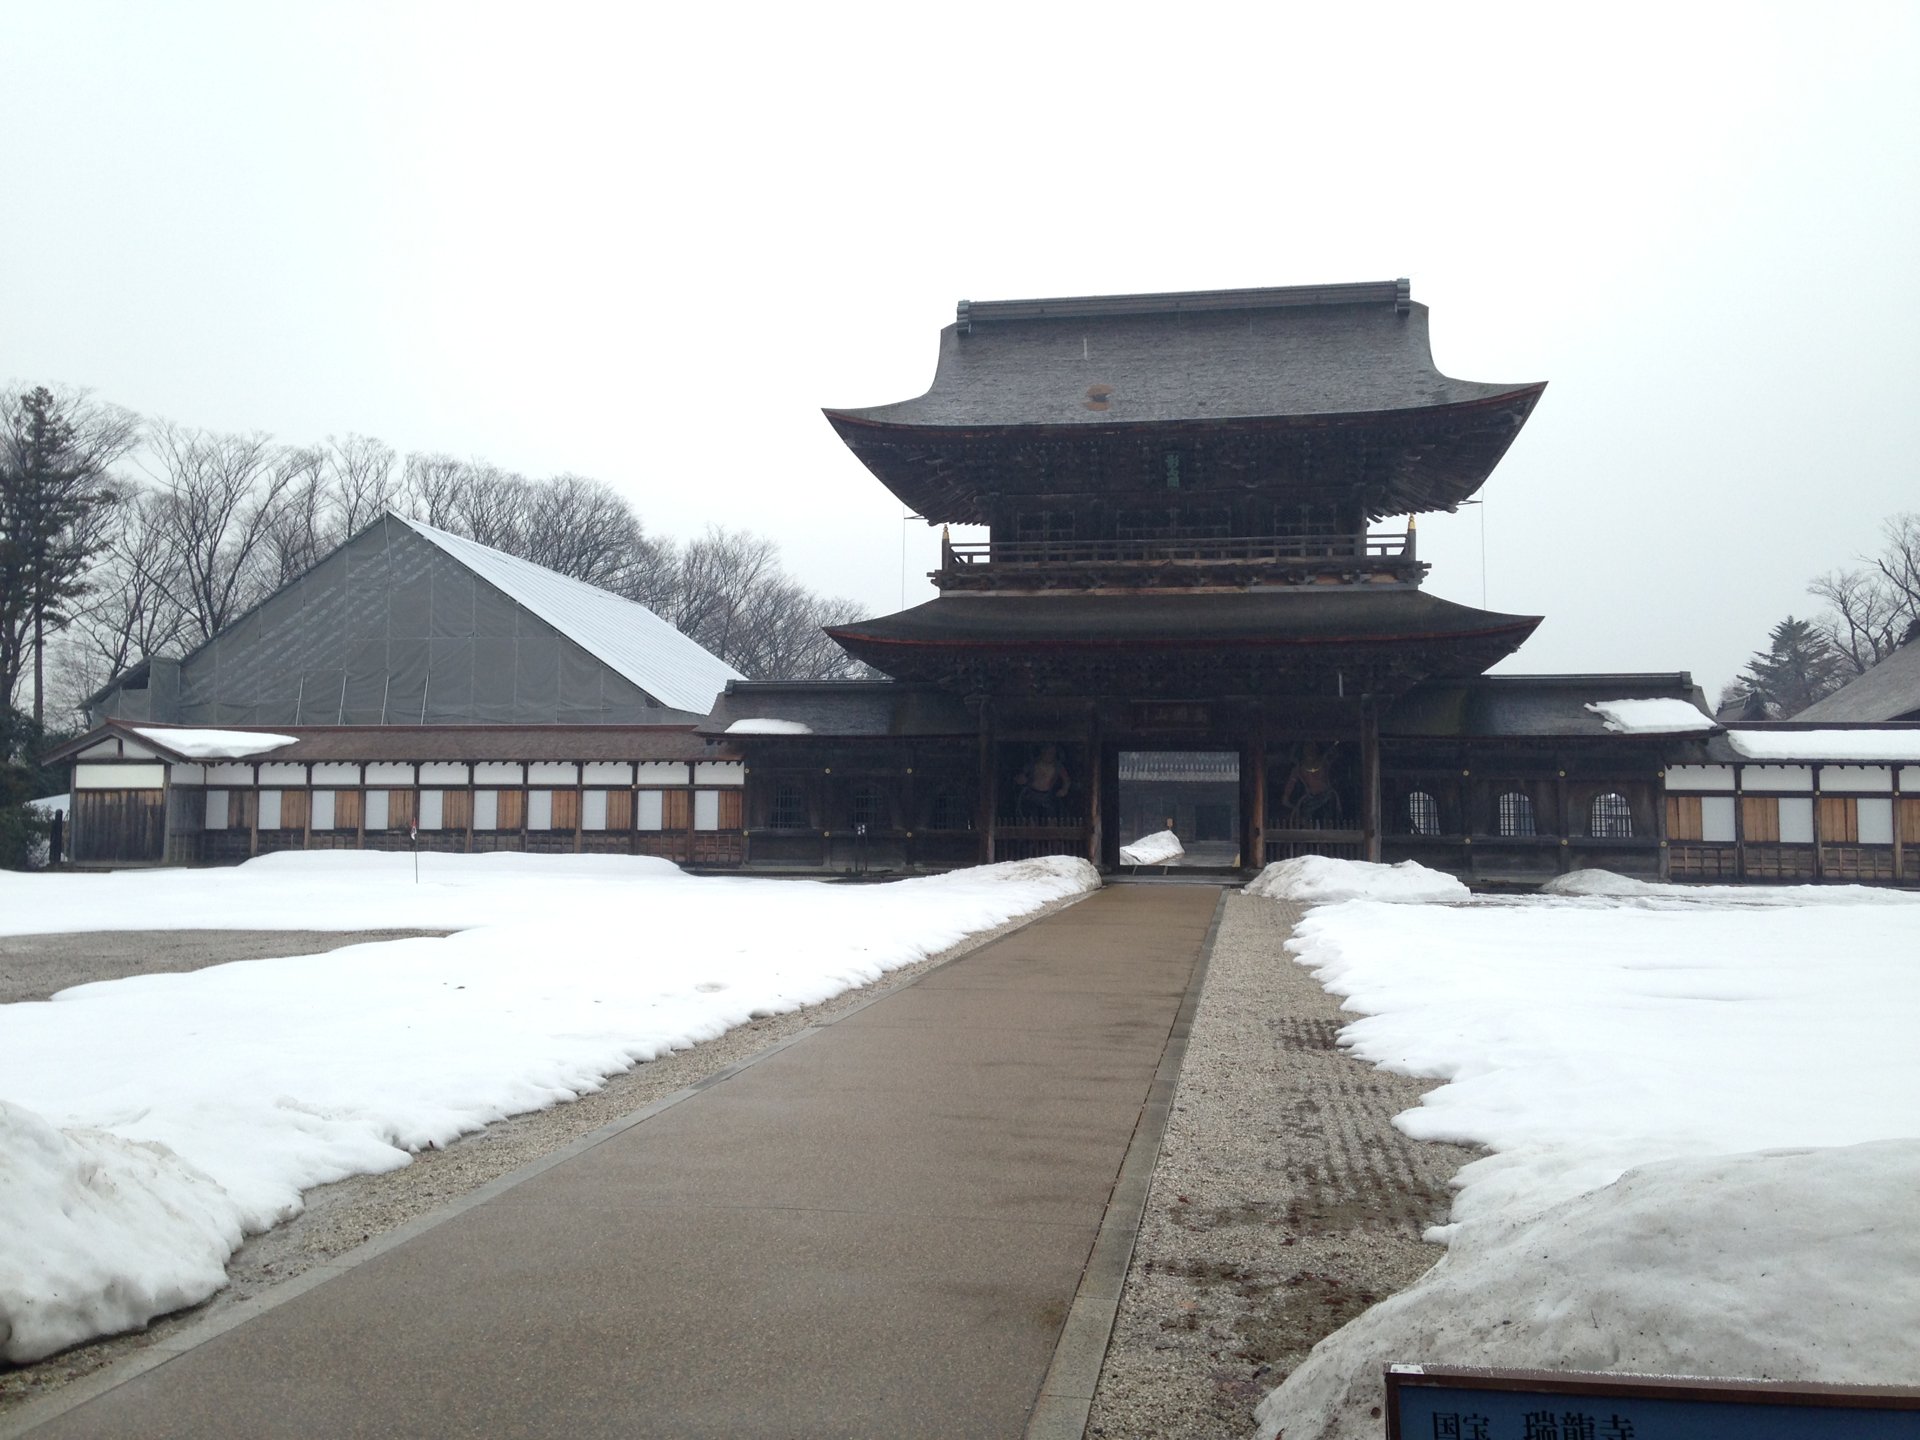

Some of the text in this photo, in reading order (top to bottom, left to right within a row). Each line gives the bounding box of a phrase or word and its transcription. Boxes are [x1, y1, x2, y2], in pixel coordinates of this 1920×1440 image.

[1433, 1410, 1635, 1440] 国宝 瑞龍寺
